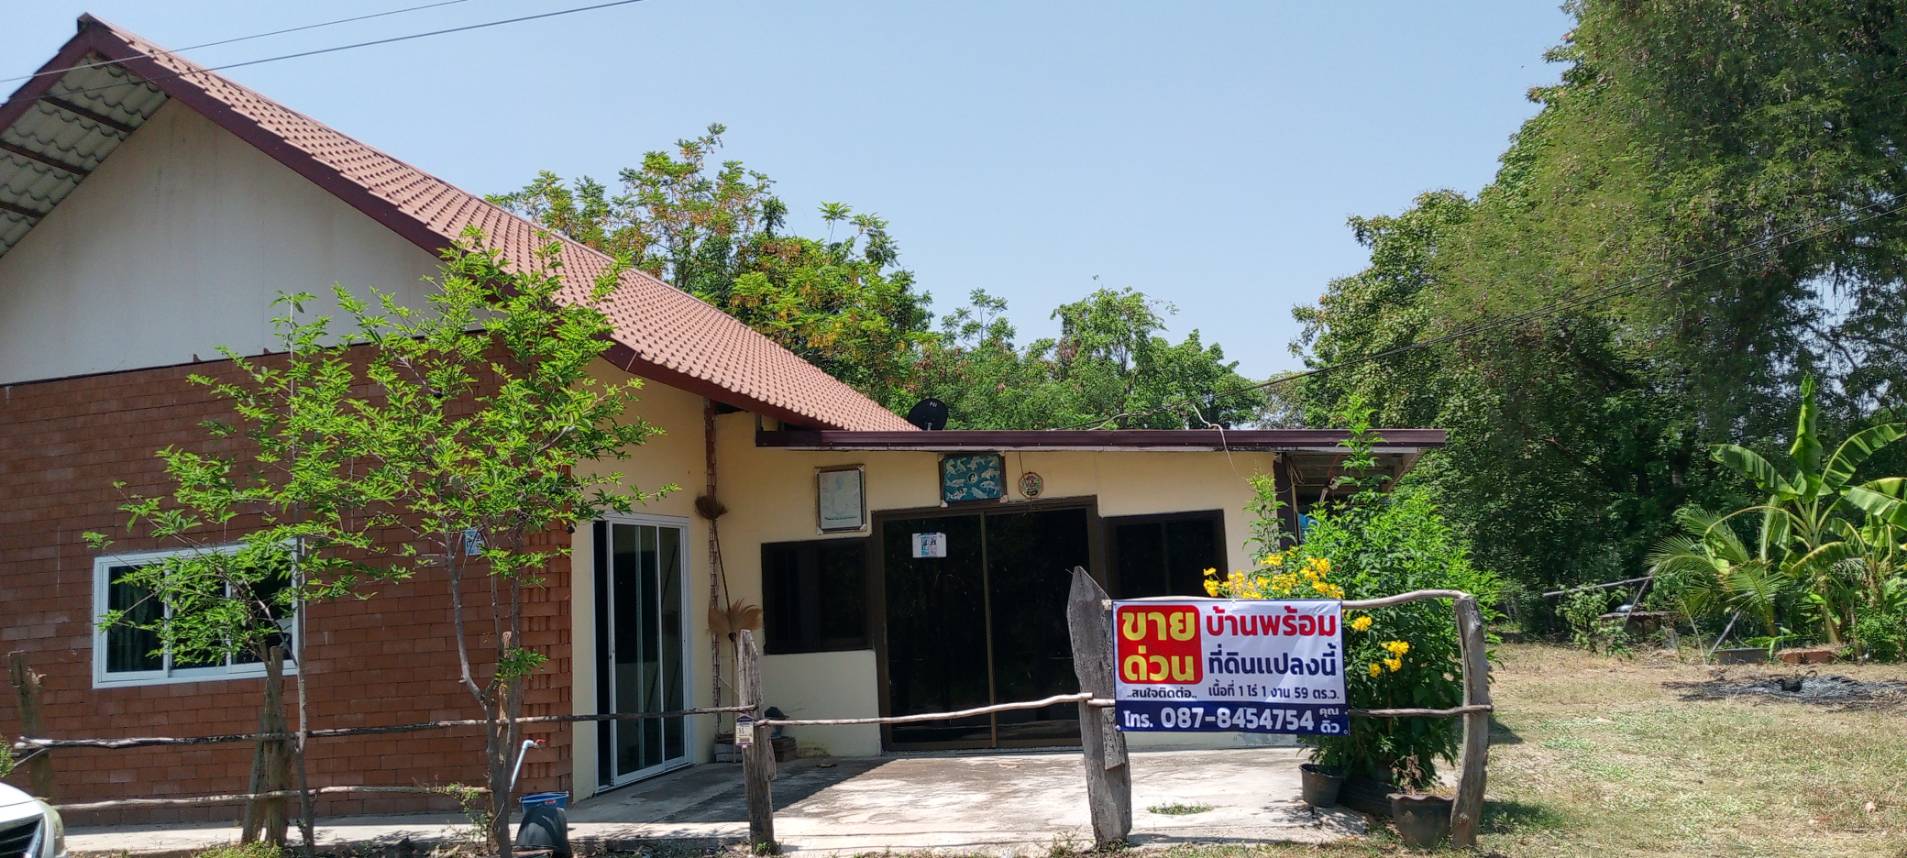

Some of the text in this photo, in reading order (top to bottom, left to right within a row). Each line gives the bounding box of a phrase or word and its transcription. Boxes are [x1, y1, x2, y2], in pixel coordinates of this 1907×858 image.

[1122, 611, 1196, 641] ขาย
[1206, 606, 1336, 637] บ้านพร้อม
[1123, 645, 1195, 681] ด่วน
[1208, 643, 1337, 676] ที่ดินแปลงนี้
[1208, 679, 1340, 700] เนื้อที่ 1 ไร่ 1 งาน 59 ตร.ว.
[1123, 706, 1315, 731] โทร. 087-8454754
[1319, 707, 1340, 719] คุณ
[1320, 719, 1340, 734] ดิว
